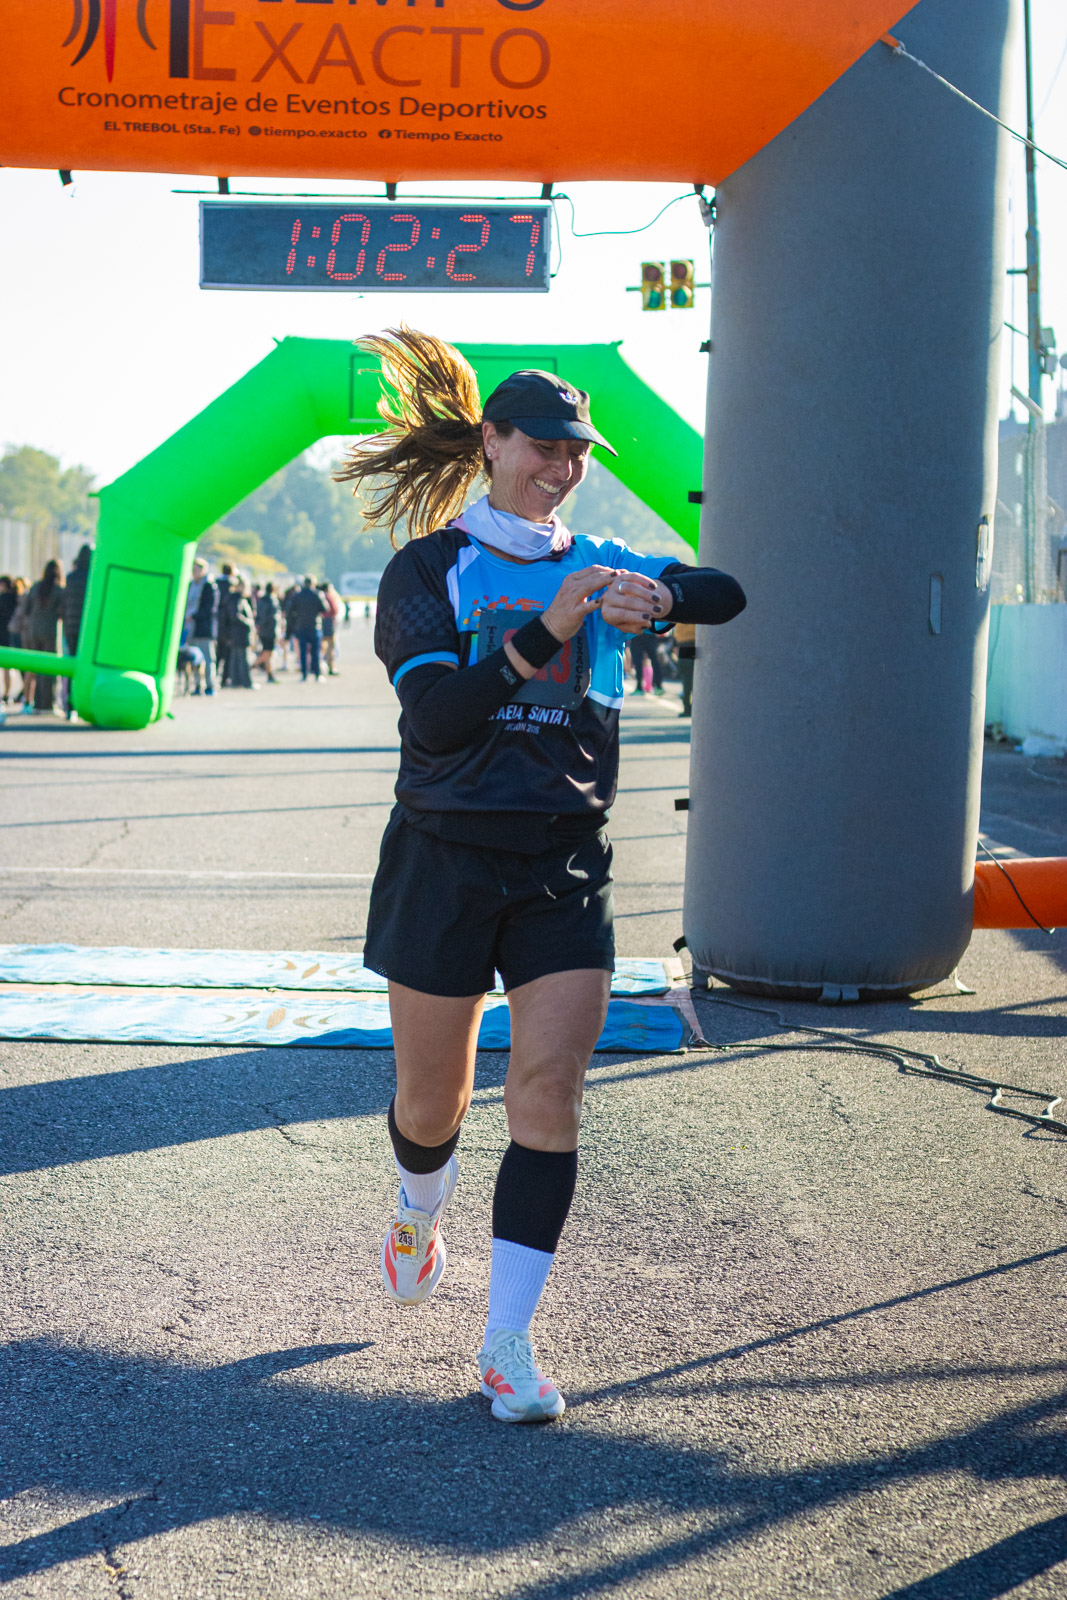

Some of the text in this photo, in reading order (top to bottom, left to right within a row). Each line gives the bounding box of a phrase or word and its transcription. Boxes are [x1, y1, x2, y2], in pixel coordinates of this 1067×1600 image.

[193, 0, 551, 90] EXACTO
[58, 86, 548, 121] Cronometraje de Eventos Deportivos
[104, 121, 503, 142] EL TREBOL (Sta. Fe) tiempo.exacto Tiempo Exacto
[285, 213, 541, 282] 1:02:27
[398, 1231, 413, 1246] 243
